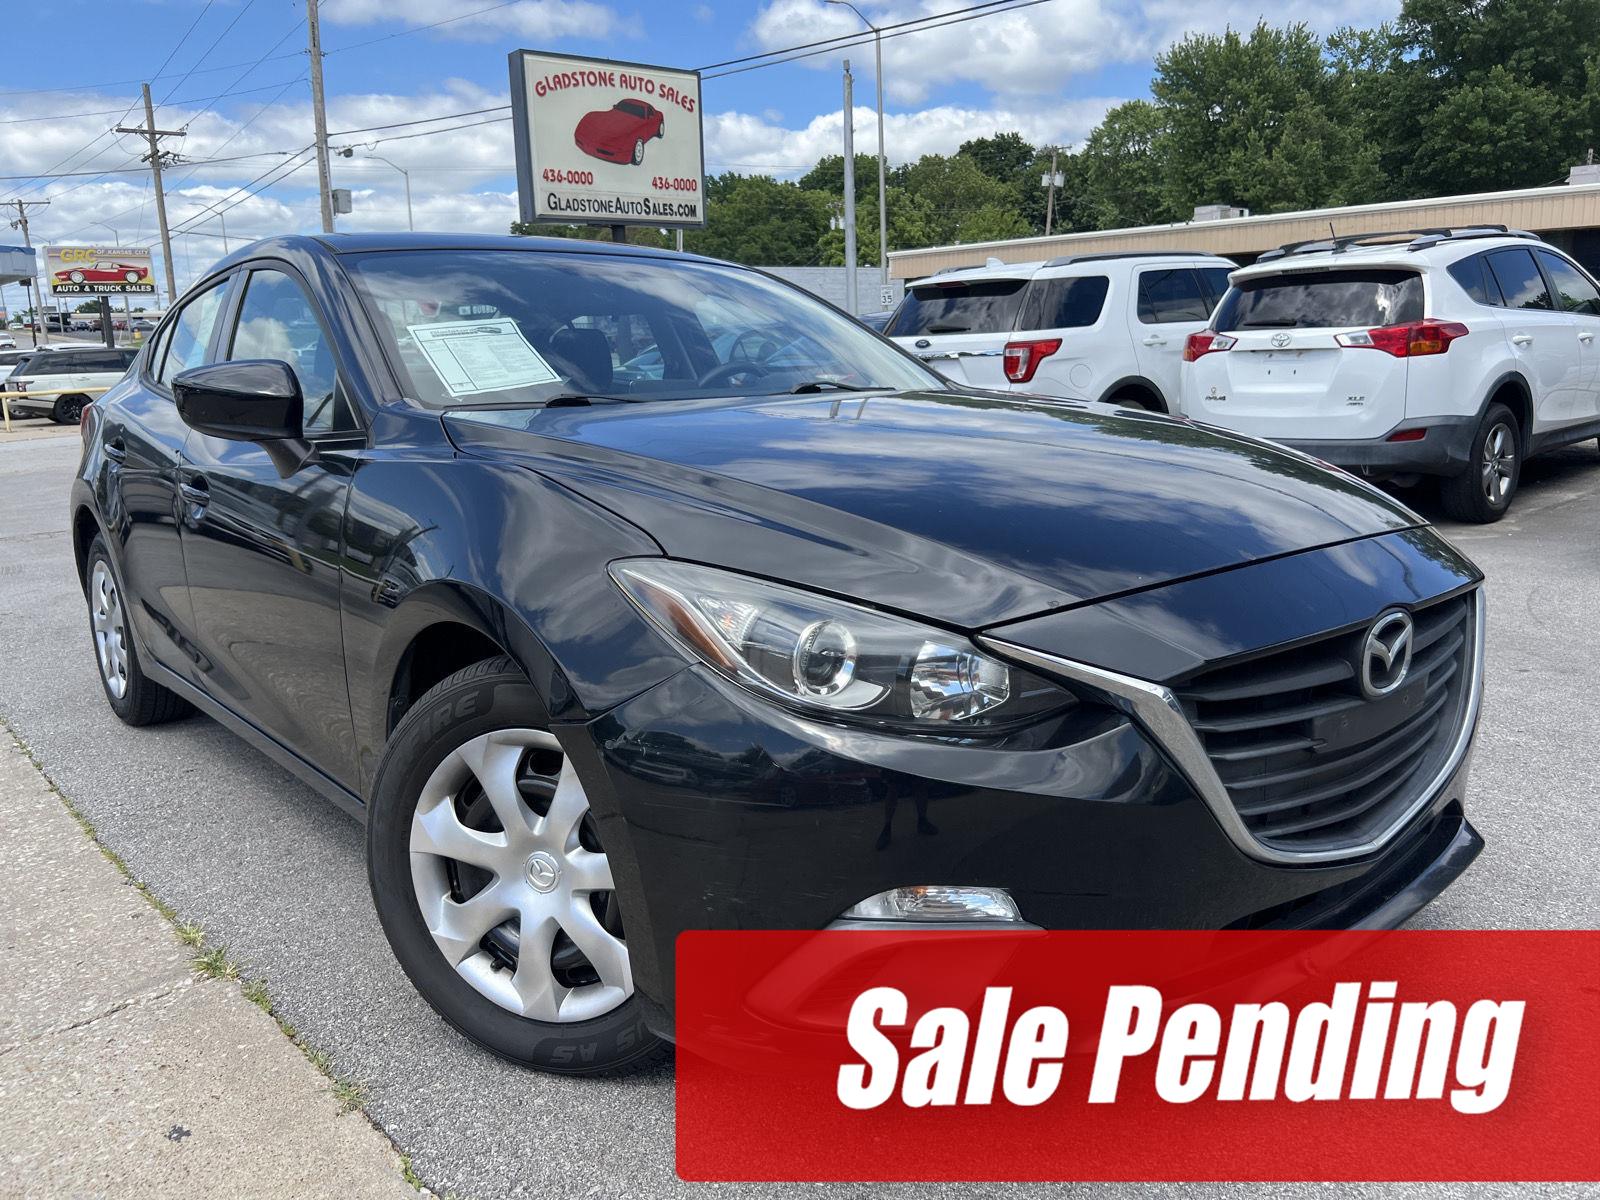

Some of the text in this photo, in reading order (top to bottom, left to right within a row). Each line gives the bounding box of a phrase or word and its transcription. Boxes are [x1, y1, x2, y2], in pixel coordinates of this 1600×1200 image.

[535, 71, 695, 112] GLADSTONE AUTO SALES
[543, 168, 593, 185] 436-0000
[652, 176, 697, 192] 436-0000
[60, 249, 97, 262] GRC
[882, 295, 893, 304] 35
